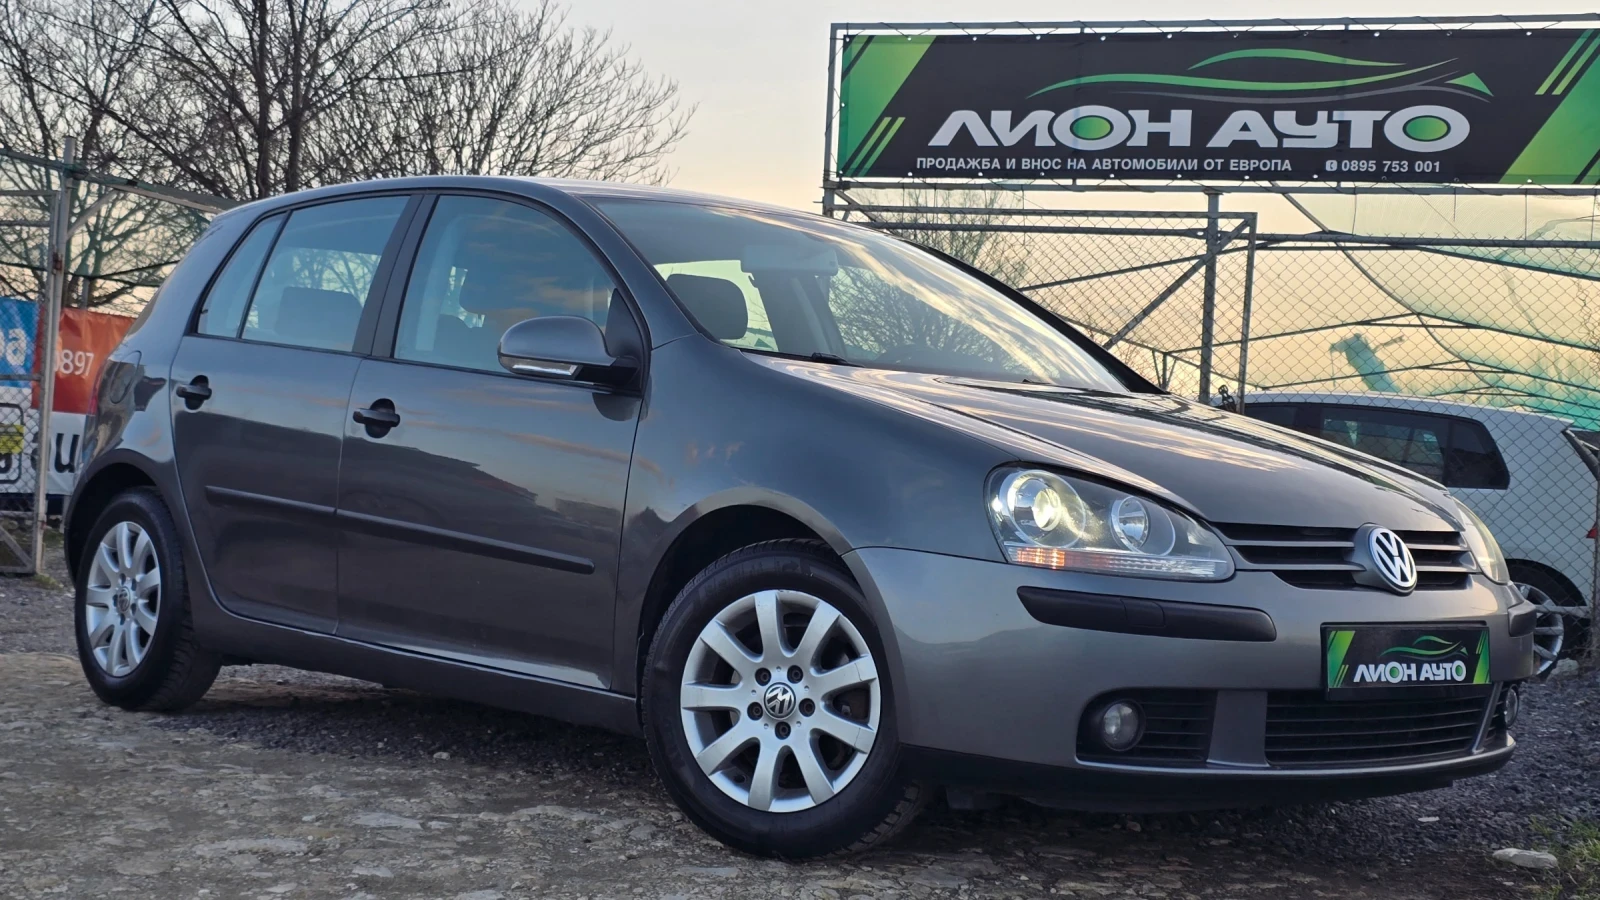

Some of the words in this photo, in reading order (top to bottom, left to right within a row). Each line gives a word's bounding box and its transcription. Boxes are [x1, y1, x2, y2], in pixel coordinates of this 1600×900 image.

[928, 105, 1192, 151] ЛИОН
[1206, 105, 1470, 152] АУТО
[917, 157, 1000, 171] ПРОДАЖБА
[1006, 158, 1016, 169] И
[1021, 158, 1061, 170] ВНОС
[1067, 158, 1087, 170] НА
[1092, 158, 1198, 171] АВТОМОБИЛИ
[1203, 159, 1224, 171] ОТ
[1230, 159, 1292, 172] ЕВРОПА
[1341, 160, 1376, 172] 0895
[1382, 161, 1409, 173] 753
[1414, 161, 1440, 173] 001
[1353, 661, 1417, 683] ЛИОН
[1420, 660, 1466, 682] АУТО
